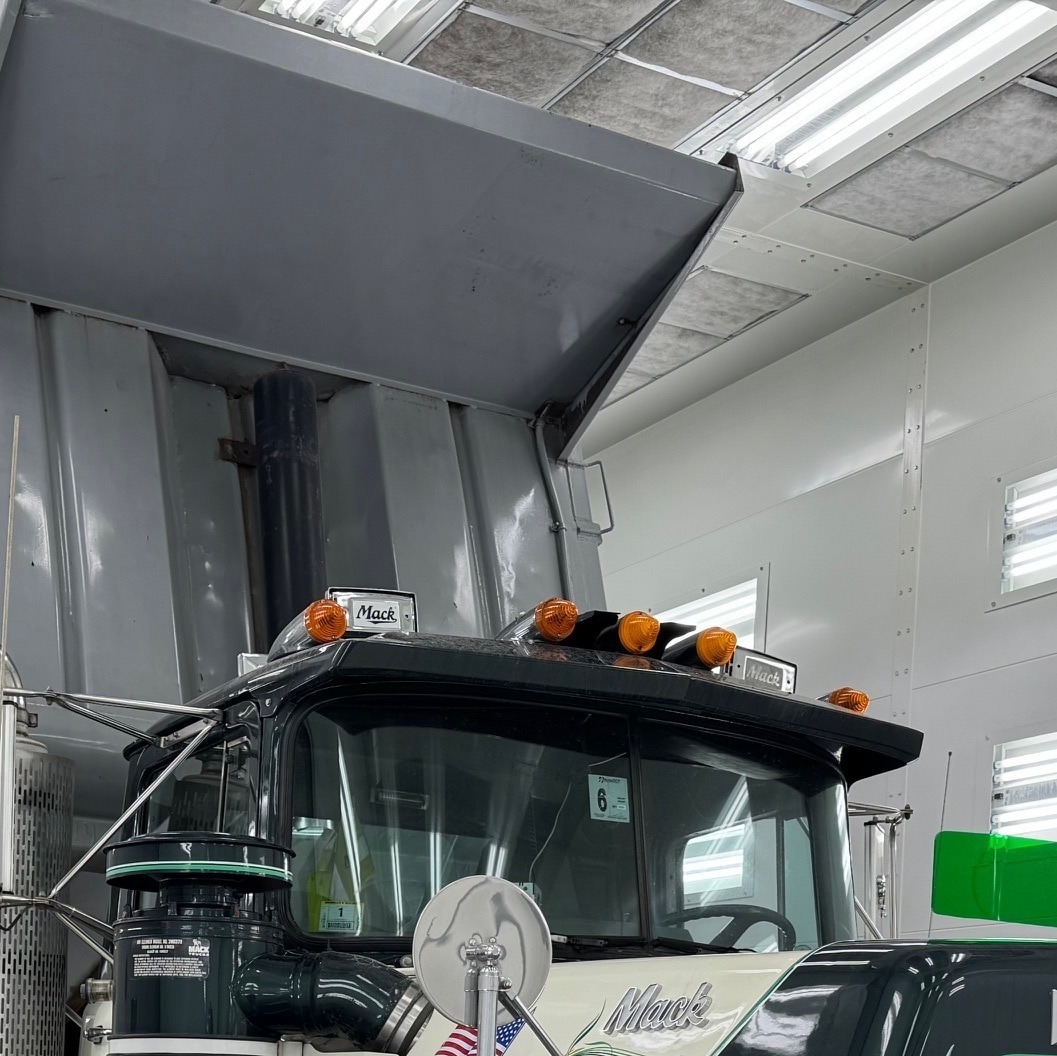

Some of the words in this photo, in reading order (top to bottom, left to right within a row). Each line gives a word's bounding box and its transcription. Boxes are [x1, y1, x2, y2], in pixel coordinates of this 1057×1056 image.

[356, 604, 398, 624] Mack
[746, 664, 780, 687] Mack
[597, 787, 608, 812] 6
[338, 907, 344, 918] 1
[188, 945, 210, 954] MACK
[603, 981, 713, 1035] Mack
